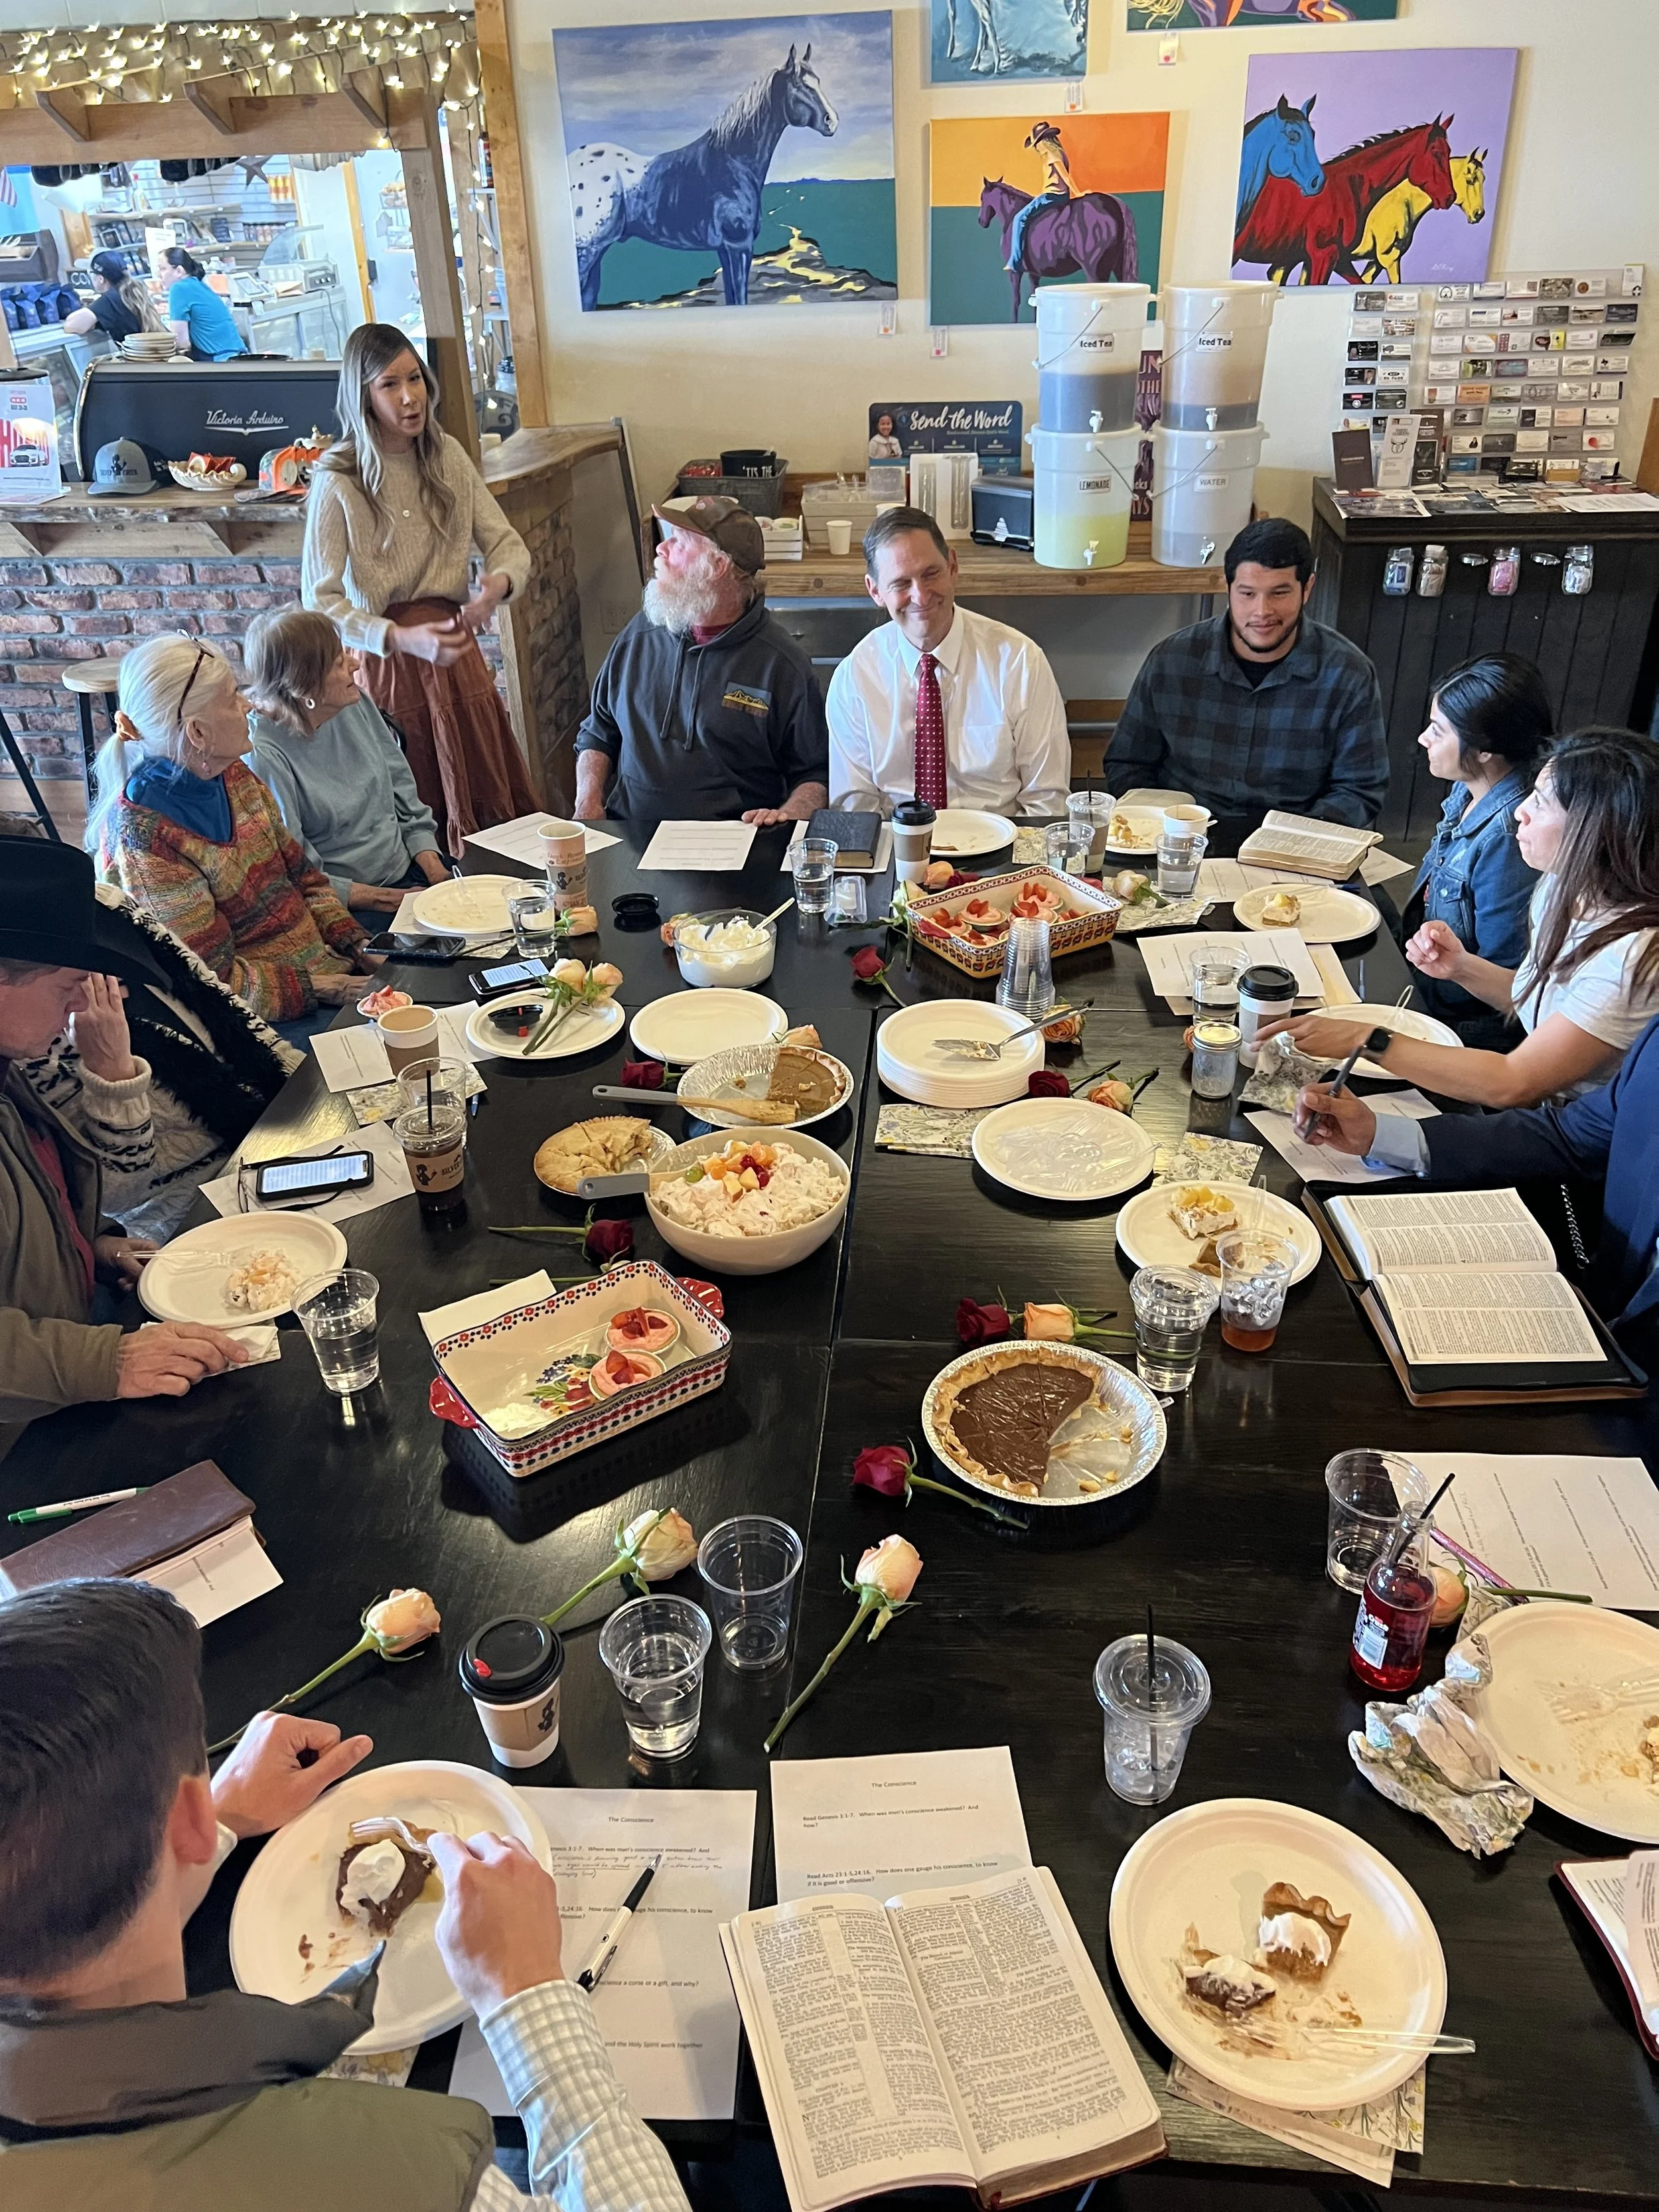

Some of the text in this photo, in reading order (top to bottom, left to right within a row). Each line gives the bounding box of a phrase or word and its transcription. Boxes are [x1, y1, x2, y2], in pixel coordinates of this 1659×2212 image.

[1198, 338, 1216, 346] Iced
[206, 409, 284, 425] Victoria Arduino
[910, 404, 1013, 431] Send the Word
[1079, 479, 1110, 490] LEMONADE
